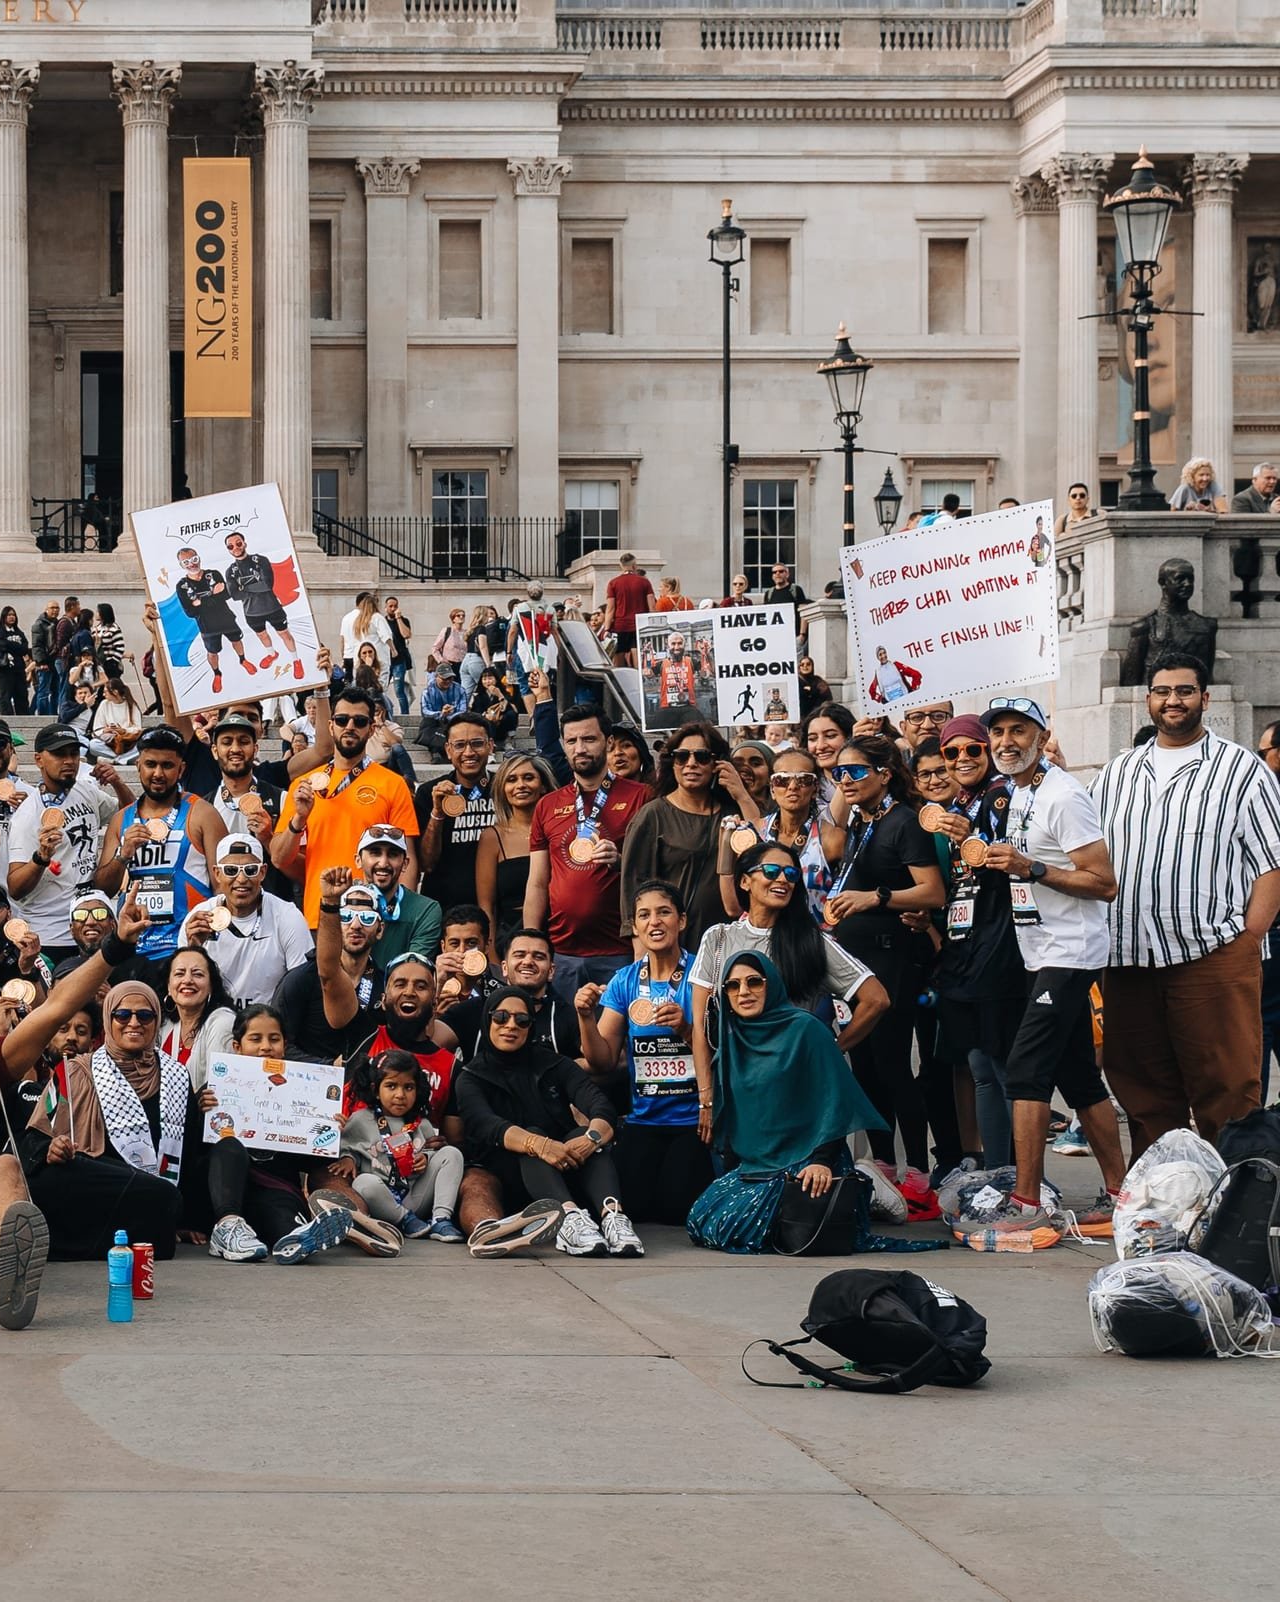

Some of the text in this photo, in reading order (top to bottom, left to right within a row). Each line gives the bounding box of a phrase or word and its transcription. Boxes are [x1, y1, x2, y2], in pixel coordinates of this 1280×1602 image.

[195, 200, 227, 360] NG200
[231, 200, 239, 361] 200 YEARS OF THE NATIONAL GALLERY
[180, 513, 241, 536] FATHER & SON
[869, 539, 1025, 589] KEEP RUNNING MAMA
[916, 589, 952, 611] CHAI
[961, 573, 1020, 602] WAITING
[1026, 570, 1039, 585] AT
[720, 611, 785, 628] HAVE A
[739, 637, 767, 652] GO
[903, 638, 934, 659] THE
[940, 623, 989, 648] FINISH
[718, 661, 795, 679] HAROON
[634, 1039, 656, 1054] tcs
[644, 1060, 687, 1077] 33338
